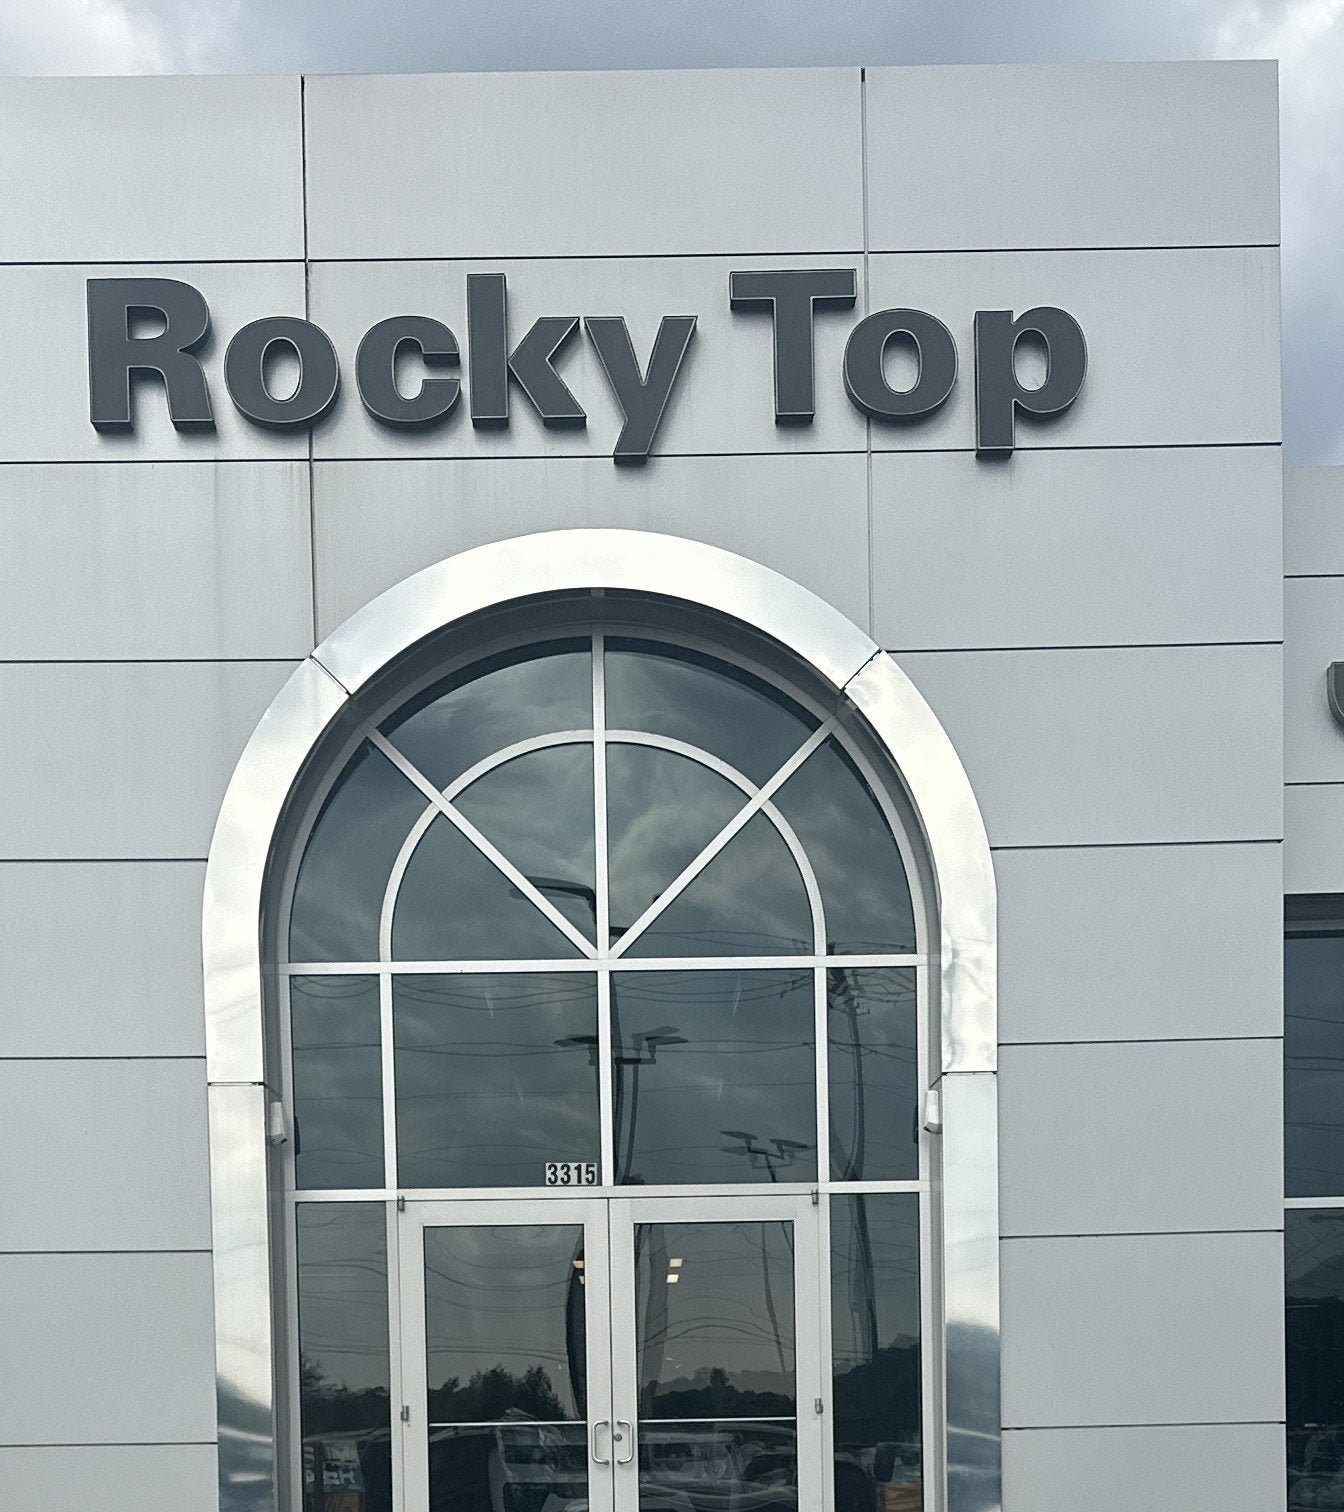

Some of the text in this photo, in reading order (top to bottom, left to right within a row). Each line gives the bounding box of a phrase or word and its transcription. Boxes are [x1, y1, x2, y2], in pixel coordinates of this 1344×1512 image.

[86, 268, 1088, 464] Rocky Top
[547, 1163, 596, 1185] 3315
